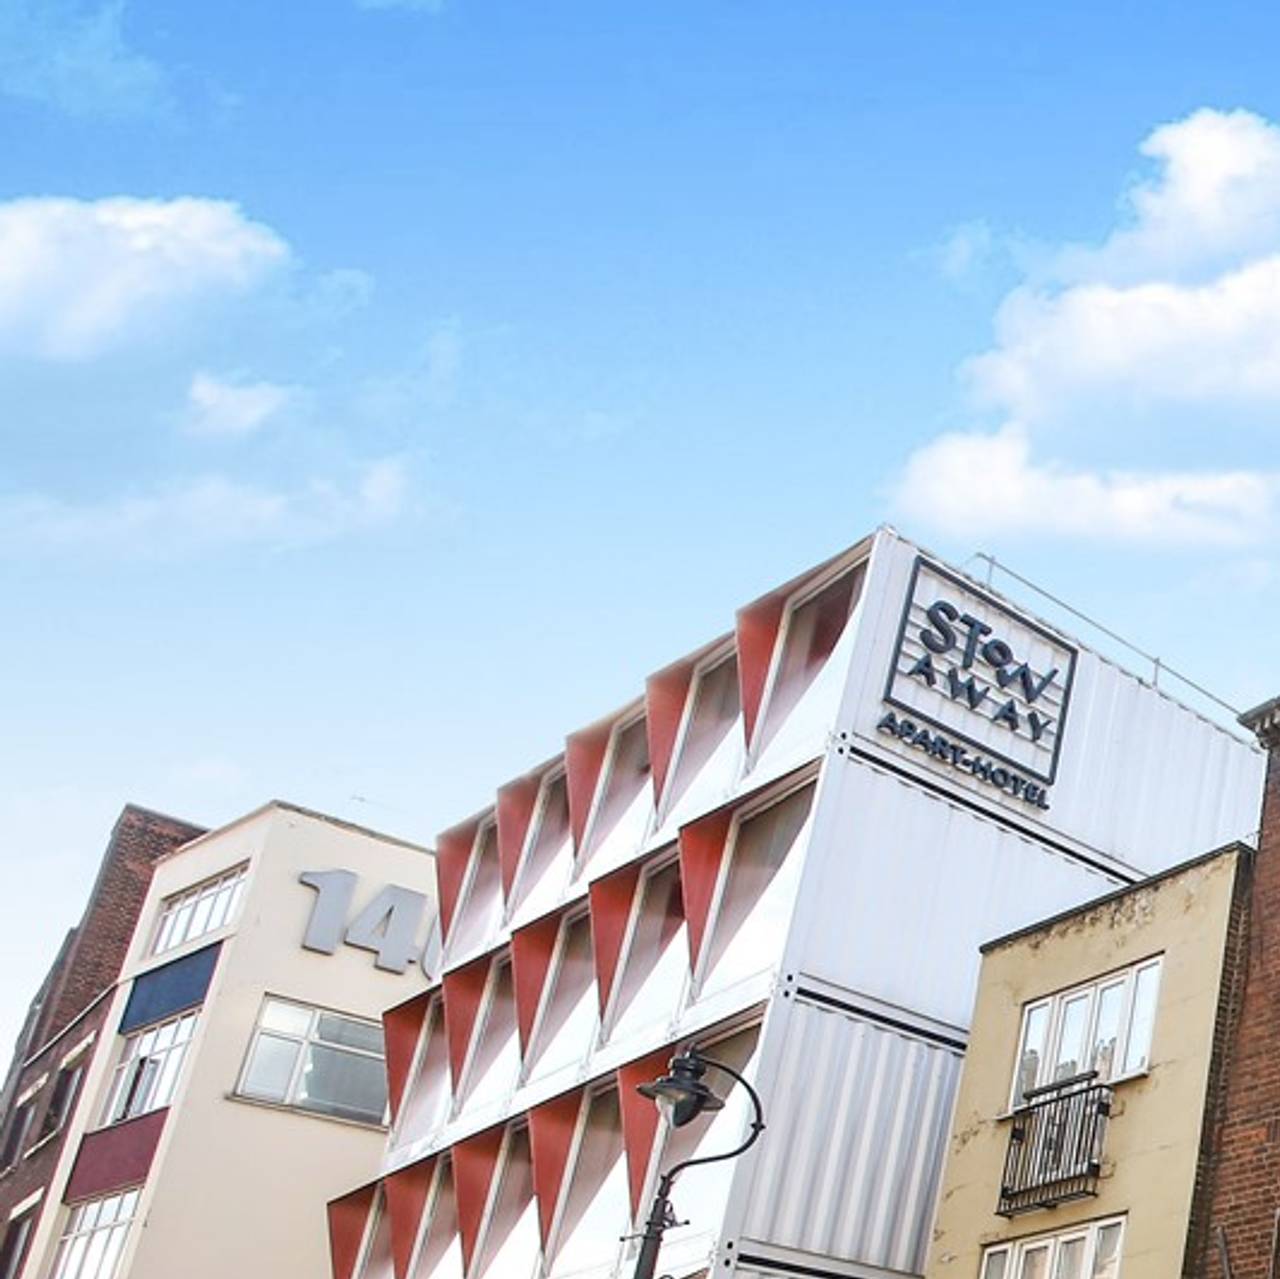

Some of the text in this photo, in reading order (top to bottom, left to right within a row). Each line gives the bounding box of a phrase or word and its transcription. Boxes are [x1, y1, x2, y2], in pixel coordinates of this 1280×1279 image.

[908, 653, 1052, 742] AWAY
[920, 600, 1059, 704] STOW
[298, 869, 441, 982] 14
